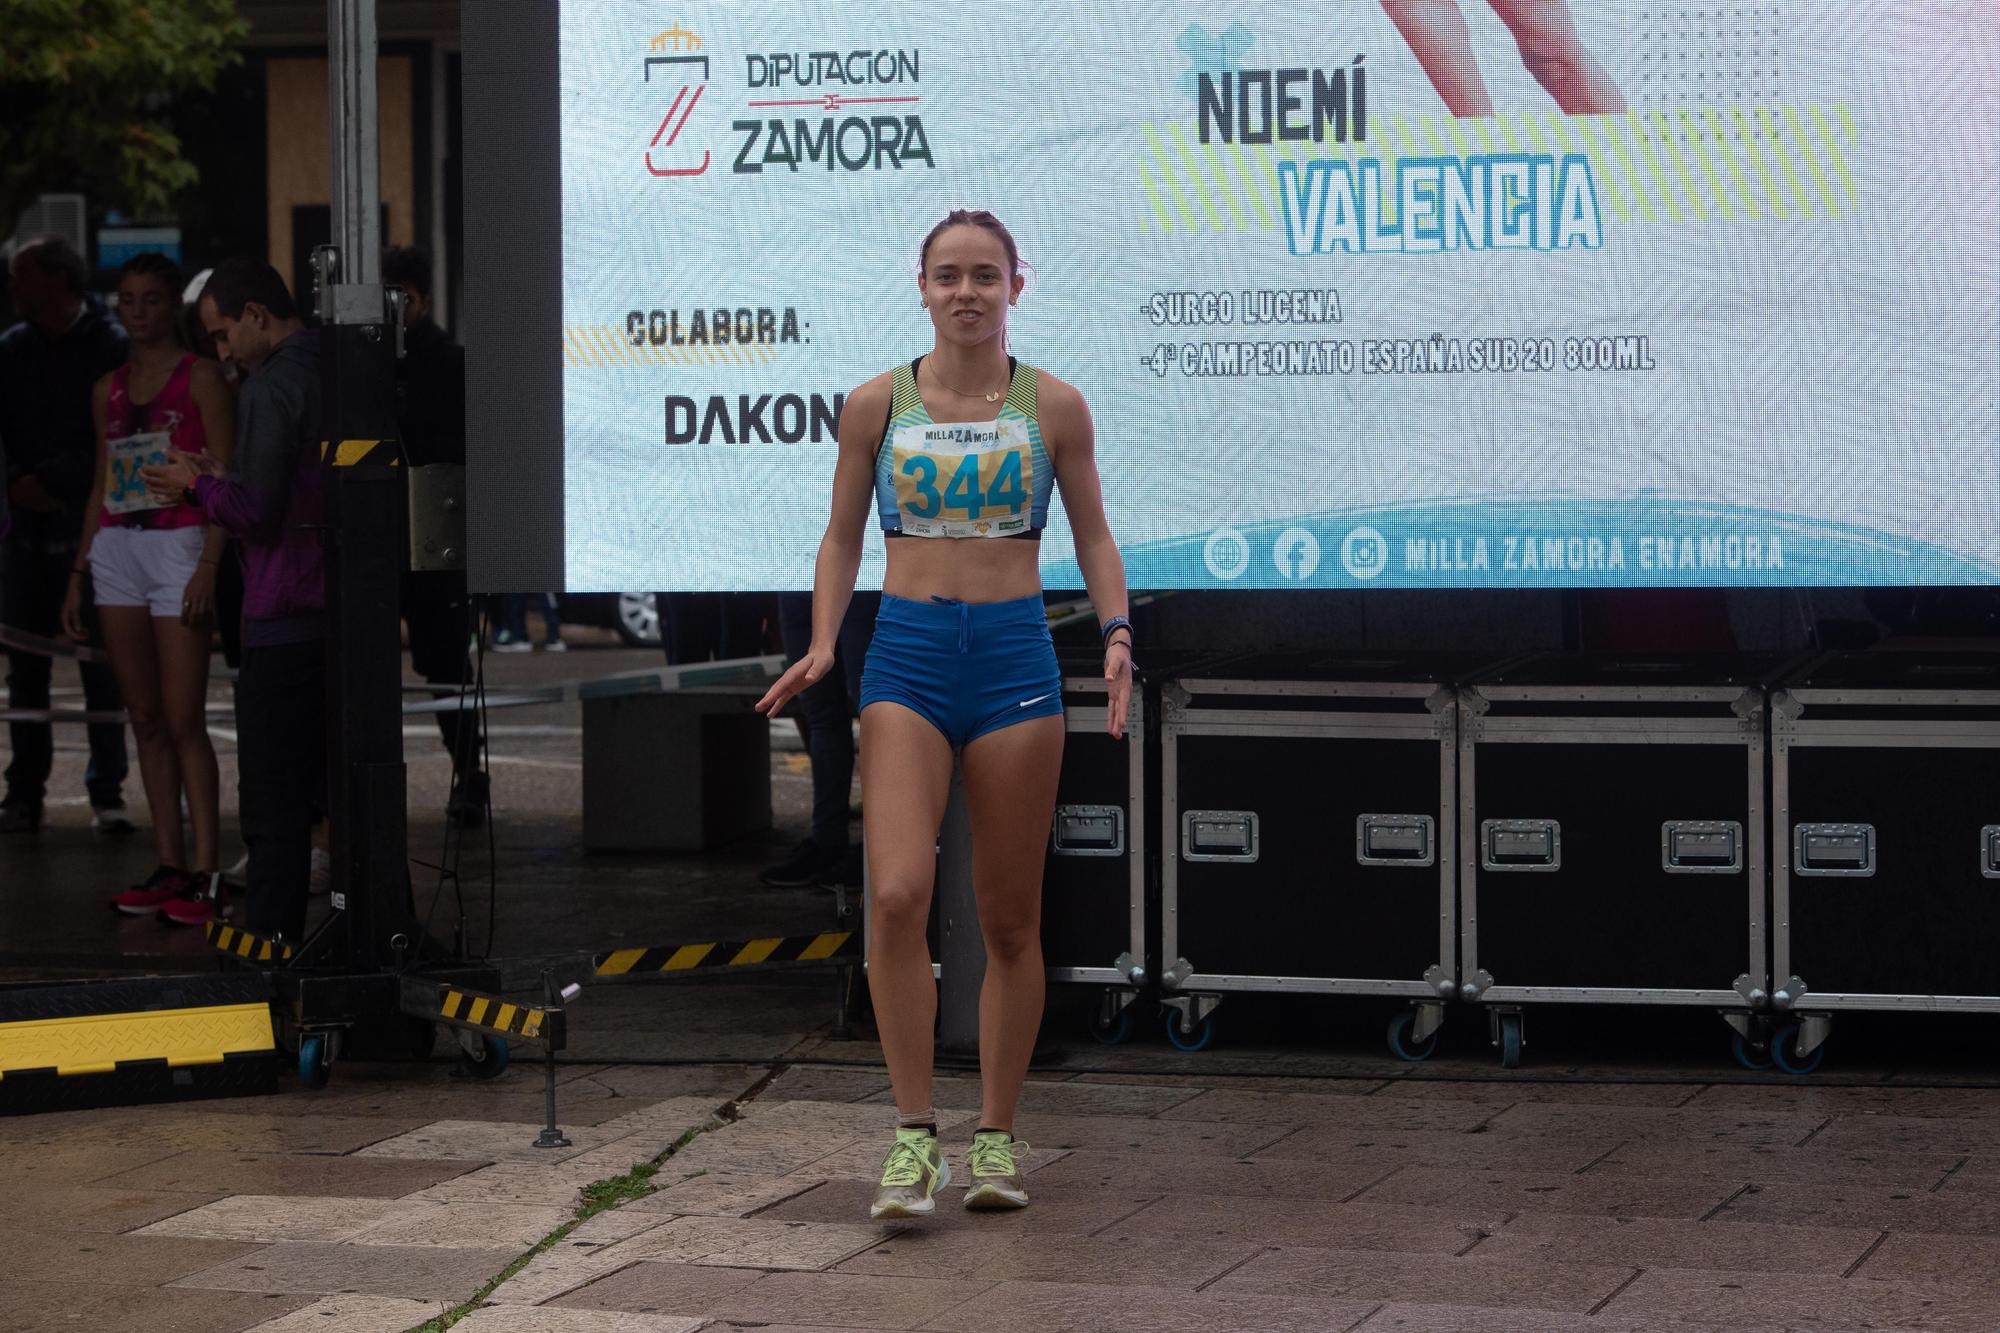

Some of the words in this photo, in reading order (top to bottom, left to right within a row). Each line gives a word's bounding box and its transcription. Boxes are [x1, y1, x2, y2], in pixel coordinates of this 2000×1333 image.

[1198, 54, 1366, 144] NOEMÍ
[732, 114, 935, 174] ZAMORA
[1278, 153, 1603, 256] VALENCIA
[626, 306, 811, 346] COLABORA:
[1242, 289, 1343, 325] LUCENA
[1181, 340, 1355, 377] CAMPEONATO
[1362, 332, 1464, 374] ESPAÑA
[1467, 337, 1520, 373] SUB
[1522, 336, 1556, 372] 20
[1564, 335, 1657, 371] 800ML
[901, 450, 1028, 521] 344
[1405, 537, 1490, 571] MILLA
[1502, 536, 1625, 571] ZAMORA
[1638, 534, 1785, 571] ENAMORA
